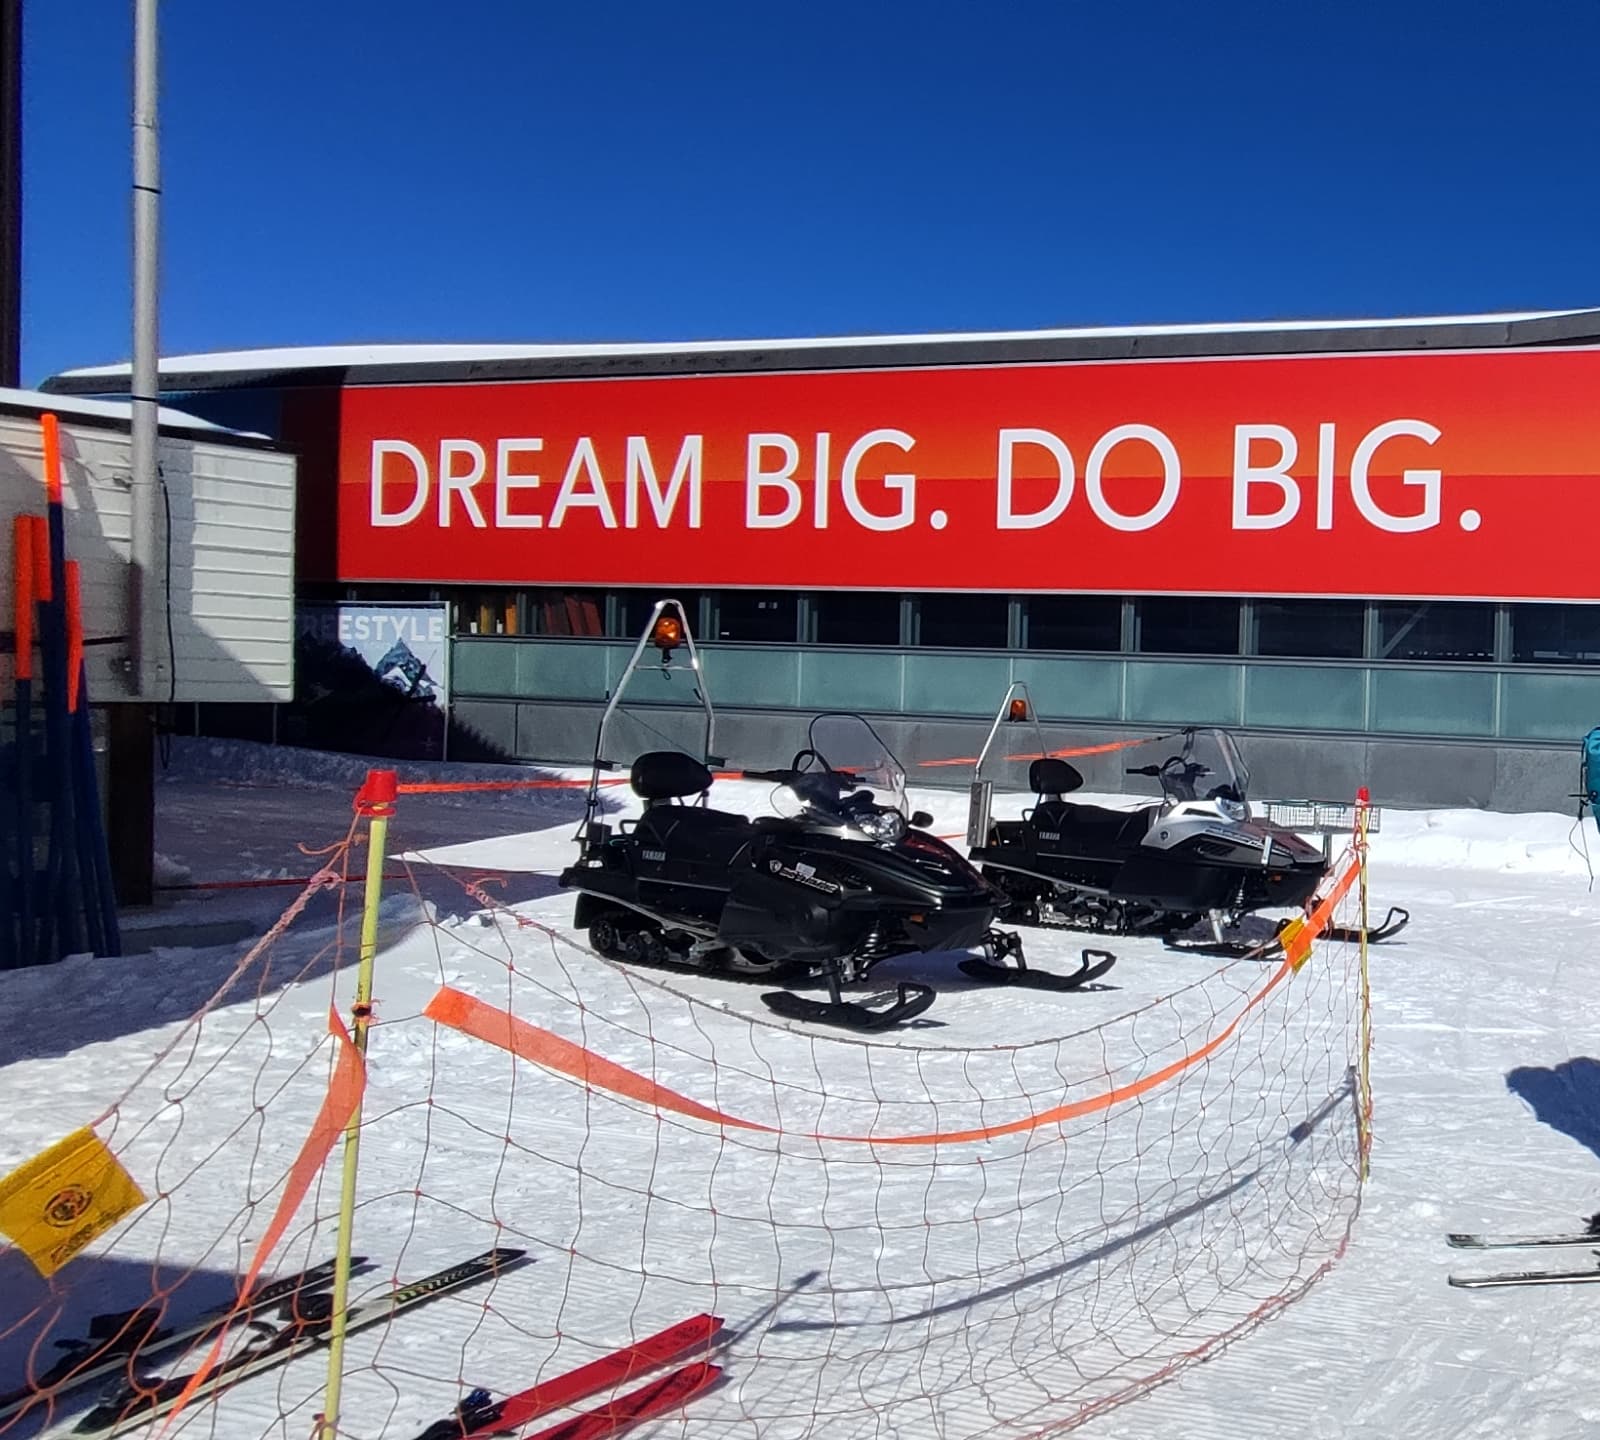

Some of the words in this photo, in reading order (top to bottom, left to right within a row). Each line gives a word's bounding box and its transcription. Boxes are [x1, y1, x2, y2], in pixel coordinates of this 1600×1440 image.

[371, 433, 704, 530] DREAM
[746, 428, 949, 532] BIG.
[996, 423, 1182, 532] DO
[1231, 419, 1482, 533] BIG.
